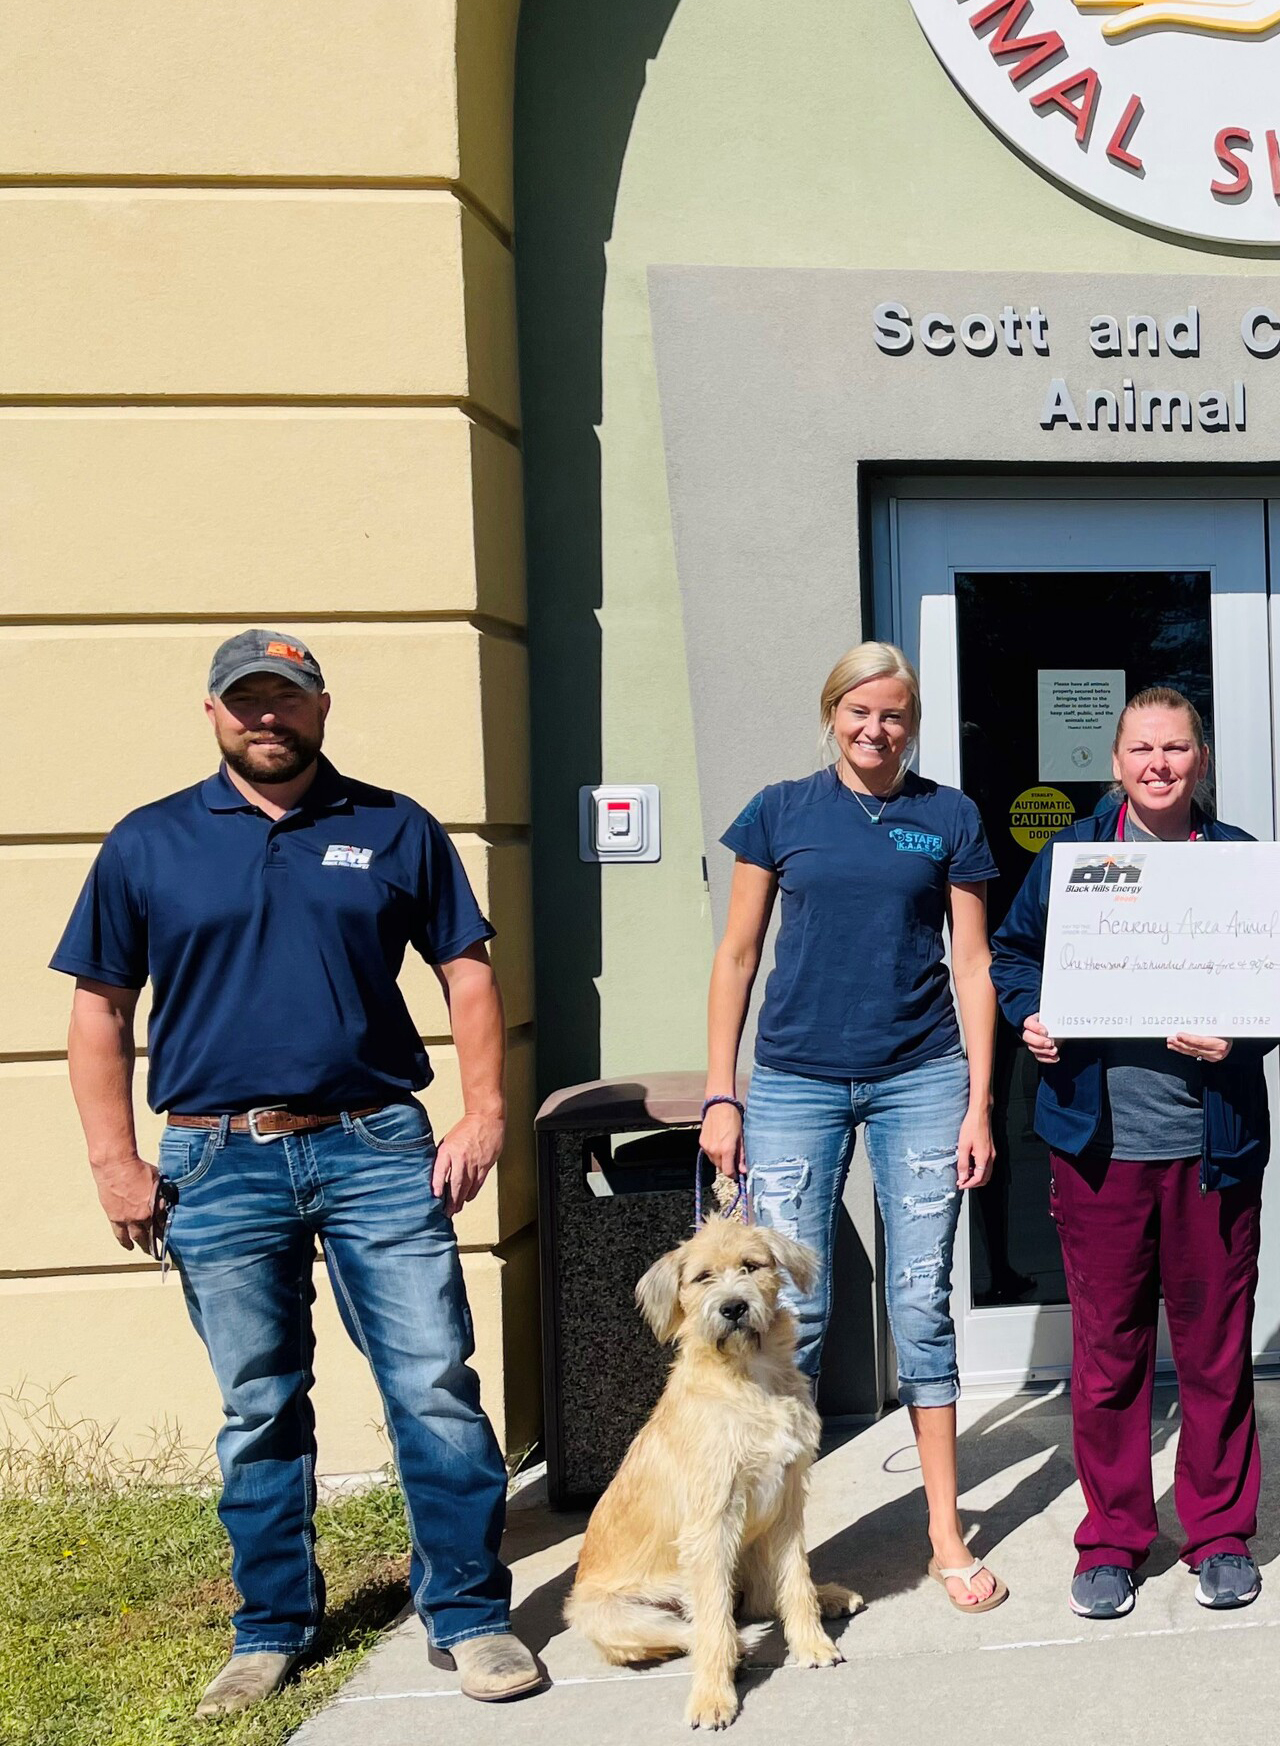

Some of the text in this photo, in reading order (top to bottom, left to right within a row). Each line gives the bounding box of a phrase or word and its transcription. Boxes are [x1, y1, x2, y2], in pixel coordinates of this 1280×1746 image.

[873, 302, 1050, 352] Scott
[1089, 305, 1199, 353] and
[1041, 378, 1246, 430] Animal
[1014, 801, 1071, 810] AUTOMATIC
[1011, 814, 1072, 826] CAUTION
[905, 833, 940, 846] STAFF
[1065, 885, 1143, 894] Black Hills Energy
[1060, 942, 1082, 970] One
[1232, 1016, 1271, 1025] 035782
